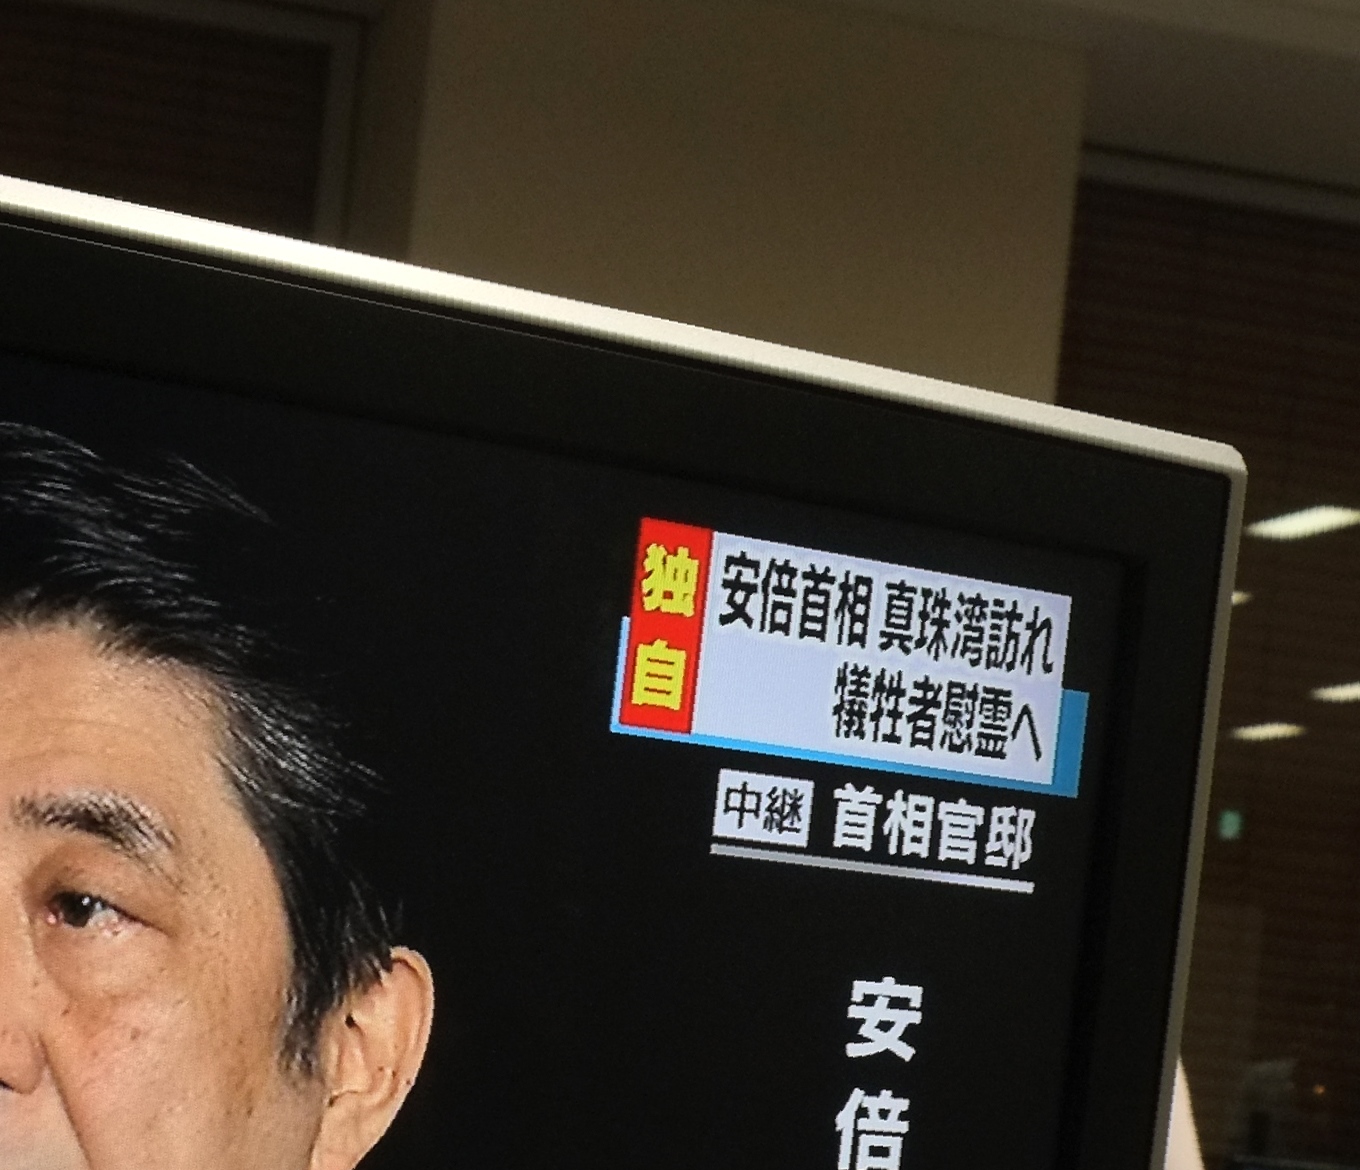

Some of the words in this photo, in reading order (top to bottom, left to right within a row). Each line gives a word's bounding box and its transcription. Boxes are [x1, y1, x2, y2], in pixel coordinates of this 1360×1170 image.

[718, 550, 874, 649] 安倍首相
[832, 661, 1042, 761] 犠牲者慰霊へ
[722, 781, 803, 836] 中継
[833, 782, 1036, 870] 首相官邸
